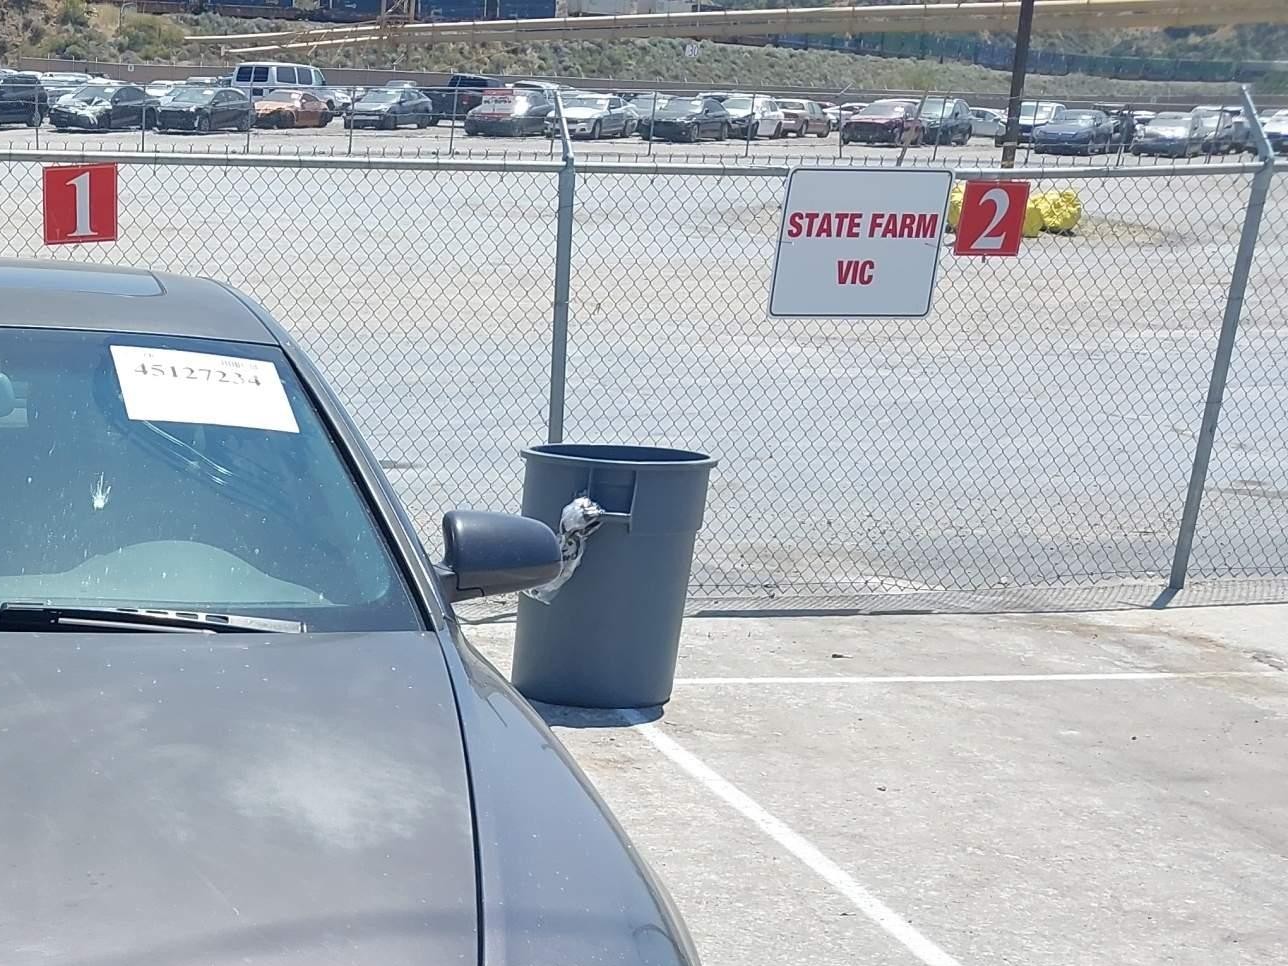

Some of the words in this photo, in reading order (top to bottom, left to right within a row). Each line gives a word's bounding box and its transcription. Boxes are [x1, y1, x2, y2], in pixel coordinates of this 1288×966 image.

[65, 170, 99, 237] 1
[787, 211, 863, 238] STATE
[868, 213, 939, 239] FARM
[970, 187, 1010, 250] 2
[836, 260, 875, 285] VIC
[133, 362, 262, 387] 45127234
